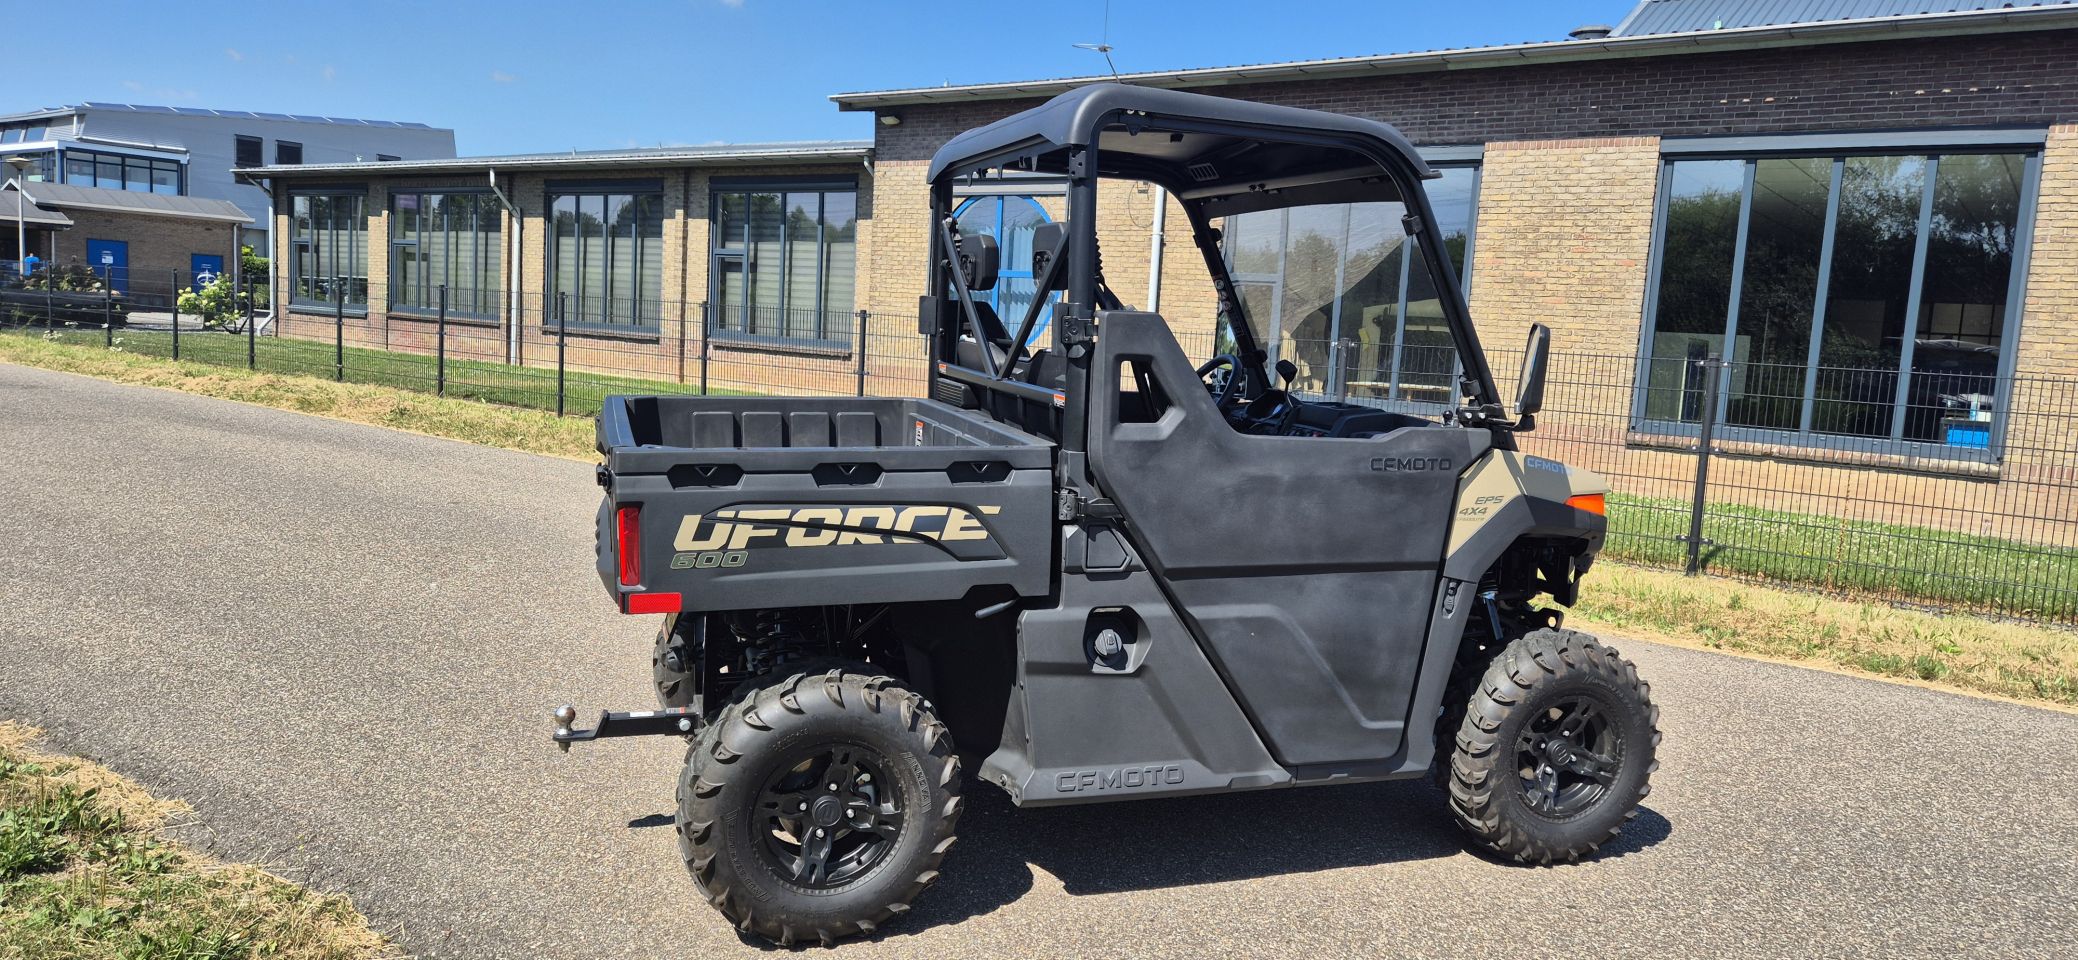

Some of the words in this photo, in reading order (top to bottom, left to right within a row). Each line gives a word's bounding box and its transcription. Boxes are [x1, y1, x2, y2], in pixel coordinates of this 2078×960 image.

[1370, 457, 1451, 472] CFMOTO
[1475, 495, 1504, 504] EPS
[1459, 507, 1488, 516] 4X4
[673, 505, 1001, 552] UFORCE
[670, 551, 749, 570] 600
[1055, 764, 1184, 792] CFMOTO
